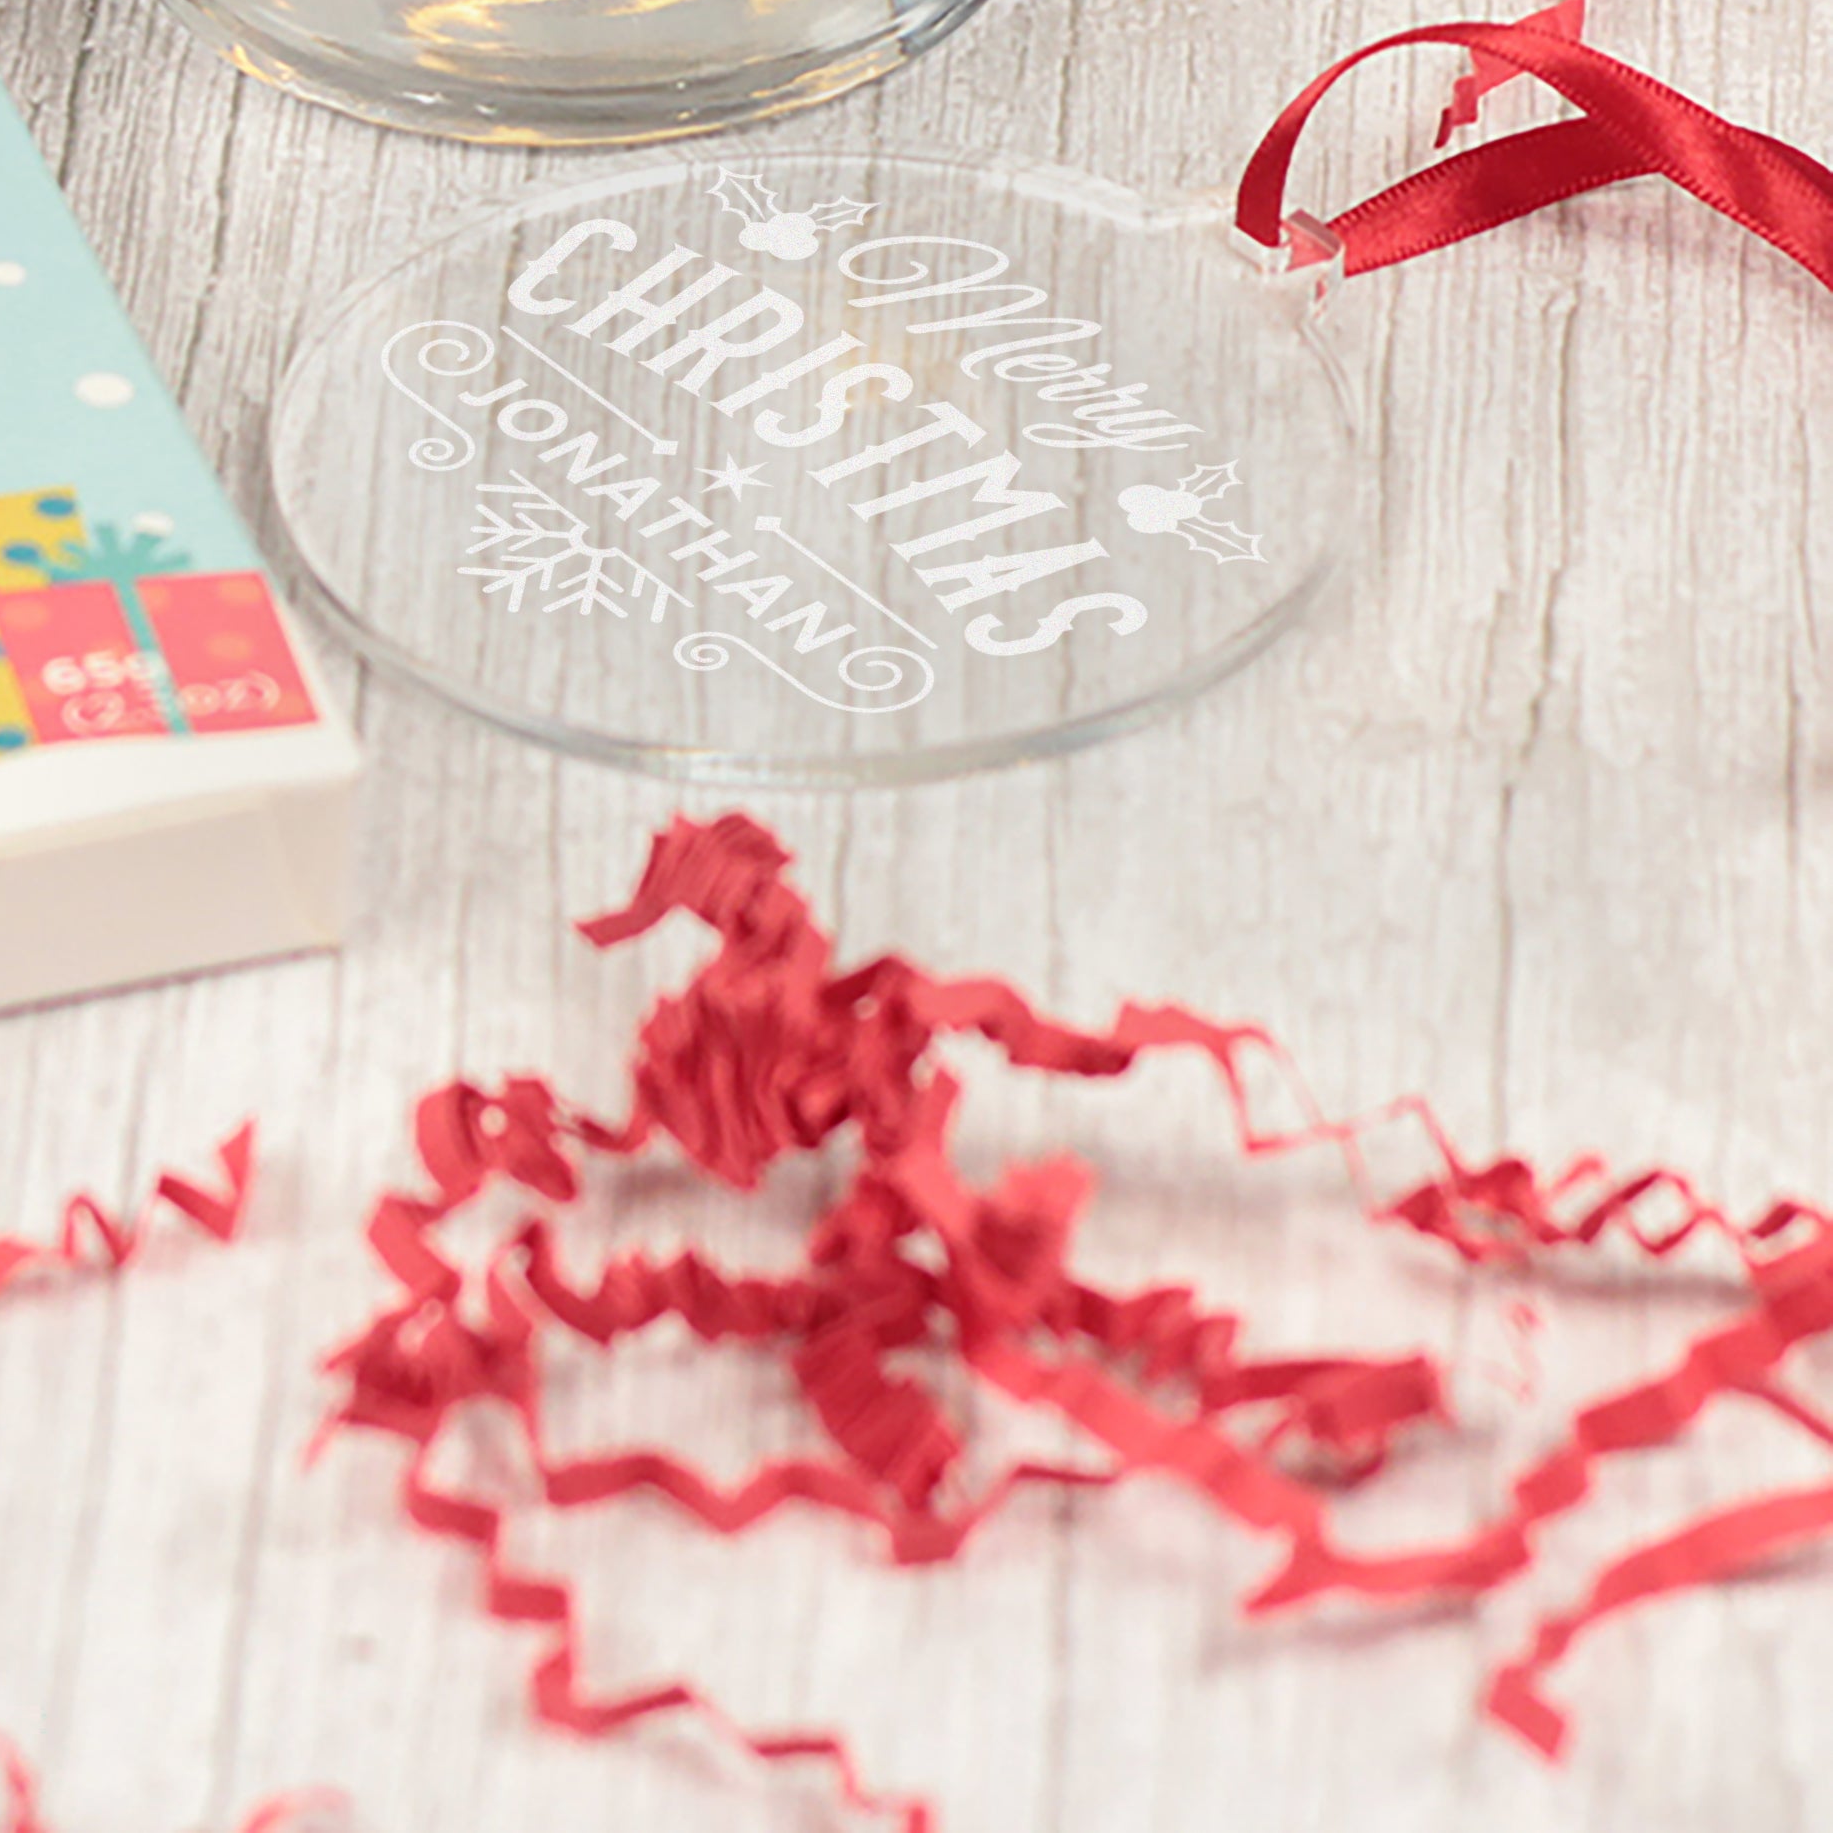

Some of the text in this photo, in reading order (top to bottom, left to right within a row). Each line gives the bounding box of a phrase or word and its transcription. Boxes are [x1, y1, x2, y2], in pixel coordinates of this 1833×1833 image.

[507, 218, 1149, 658] CHRISTMAS
[837, 234, 1206, 453] Merry
[458, 377, 859, 657] JONATHAN
